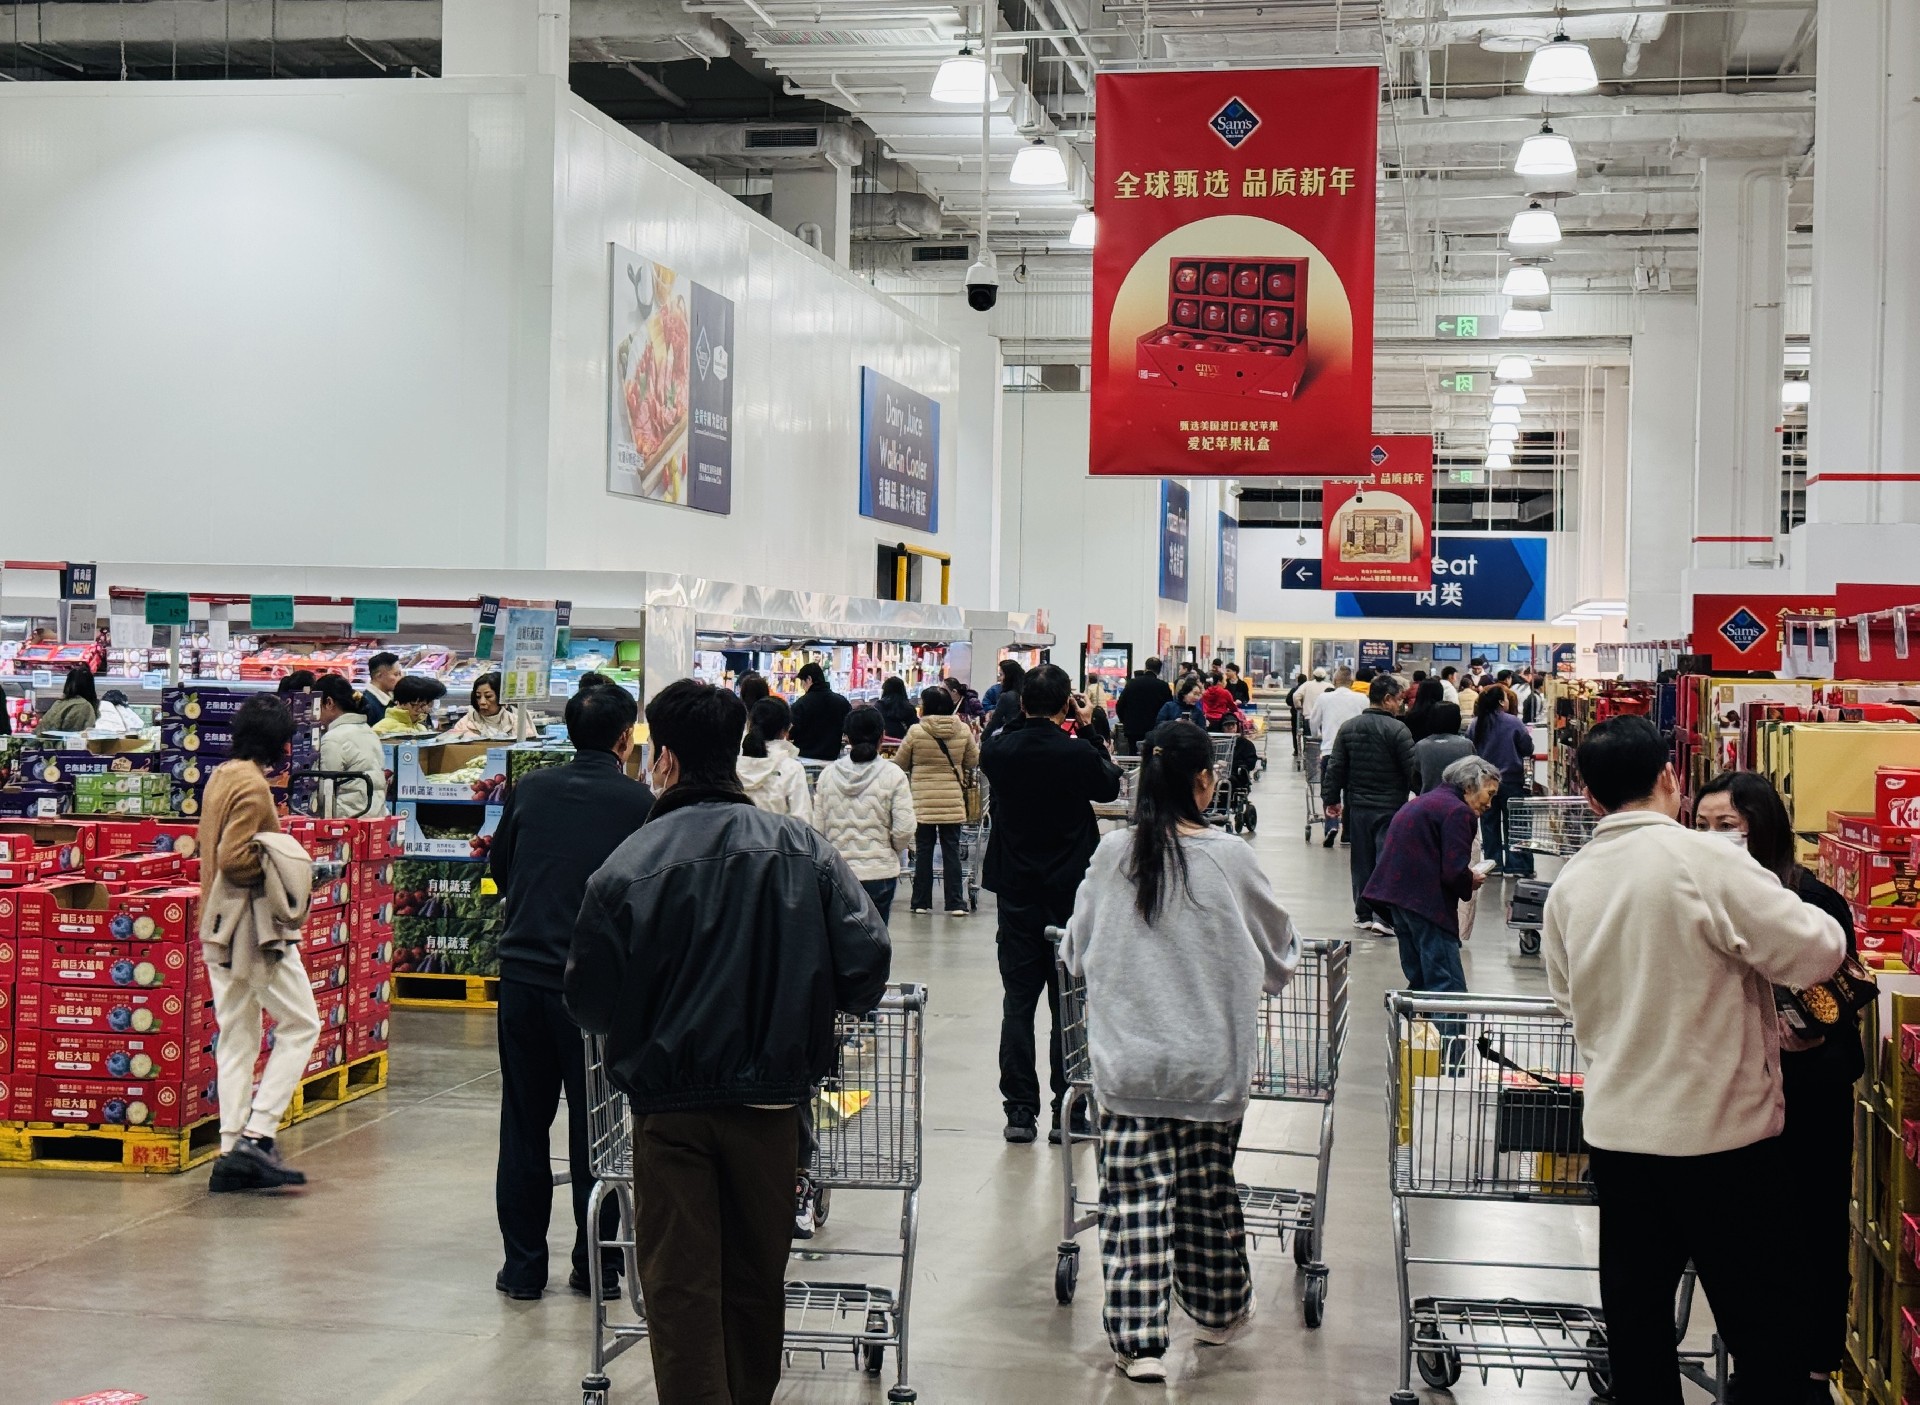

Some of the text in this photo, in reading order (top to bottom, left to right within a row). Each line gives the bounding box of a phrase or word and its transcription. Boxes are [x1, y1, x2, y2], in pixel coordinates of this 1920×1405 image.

[1217, 116, 1253, 131] Sam's
[1114, 166, 1356, 199] 全球甄选 品质新年
[1179, 420, 1279, 432] 甄选美国进口爱妃苹果
[1187, 436, 1271, 451] 爱妃苹果礼盒
[905, 446, 928, 481] Cooler
[1380, 472, 1425, 485] 品质新年
[1431, 554, 1478, 576] eat
[72, 581, 91, 595] NEW
[1726, 623, 1760, 637] Sam's
[401, 785, 434, 796] 有机蔬菜
[428, 879, 472, 893] 有机蔬菜
[426, 935, 470, 950] 有机蔬菜
